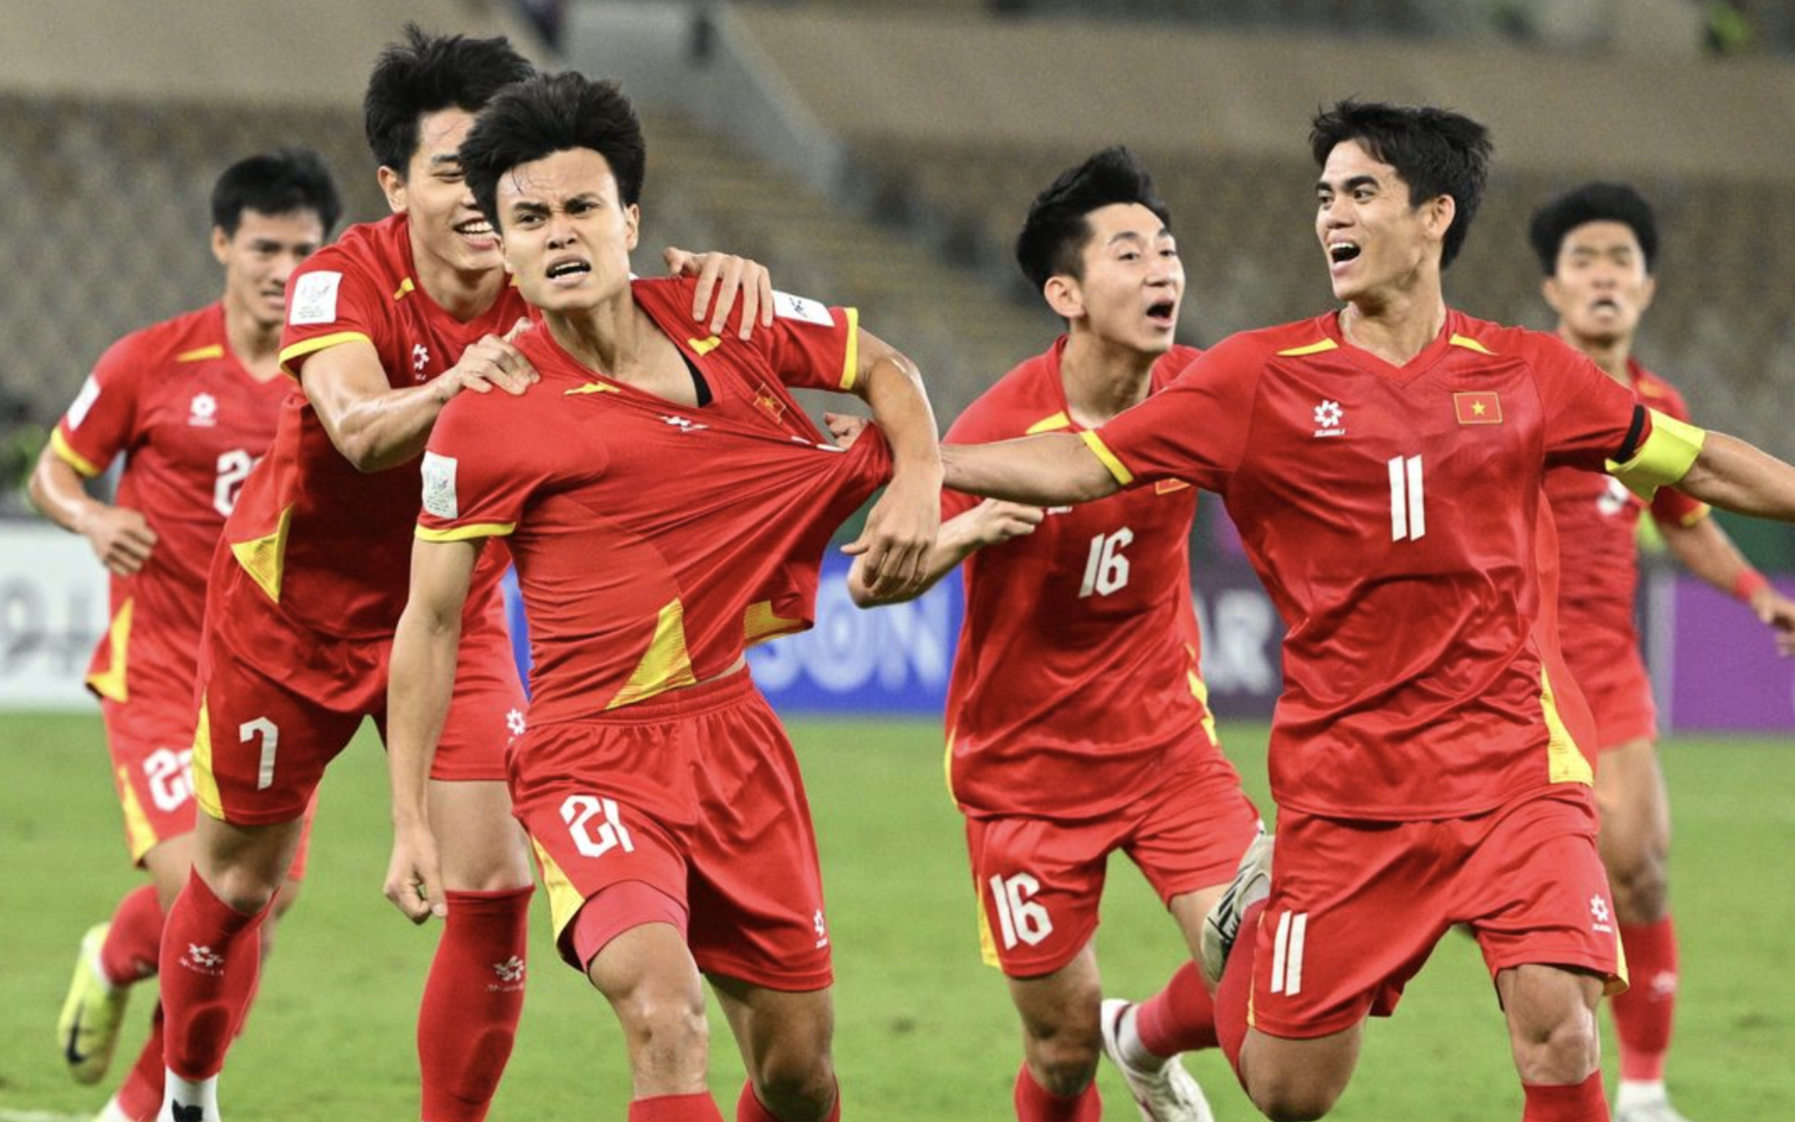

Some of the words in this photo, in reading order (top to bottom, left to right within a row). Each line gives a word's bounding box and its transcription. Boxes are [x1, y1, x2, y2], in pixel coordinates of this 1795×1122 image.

[213, 449, 263, 518] 2
[1387, 453, 1426, 542] 11
[1081, 525, 1134, 599] 16
[238, 716, 279, 790] 7
[558, 794, 635, 859] 21
[989, 872, 1053, 951] 16
[1270, 910, 1309, 997] 11
